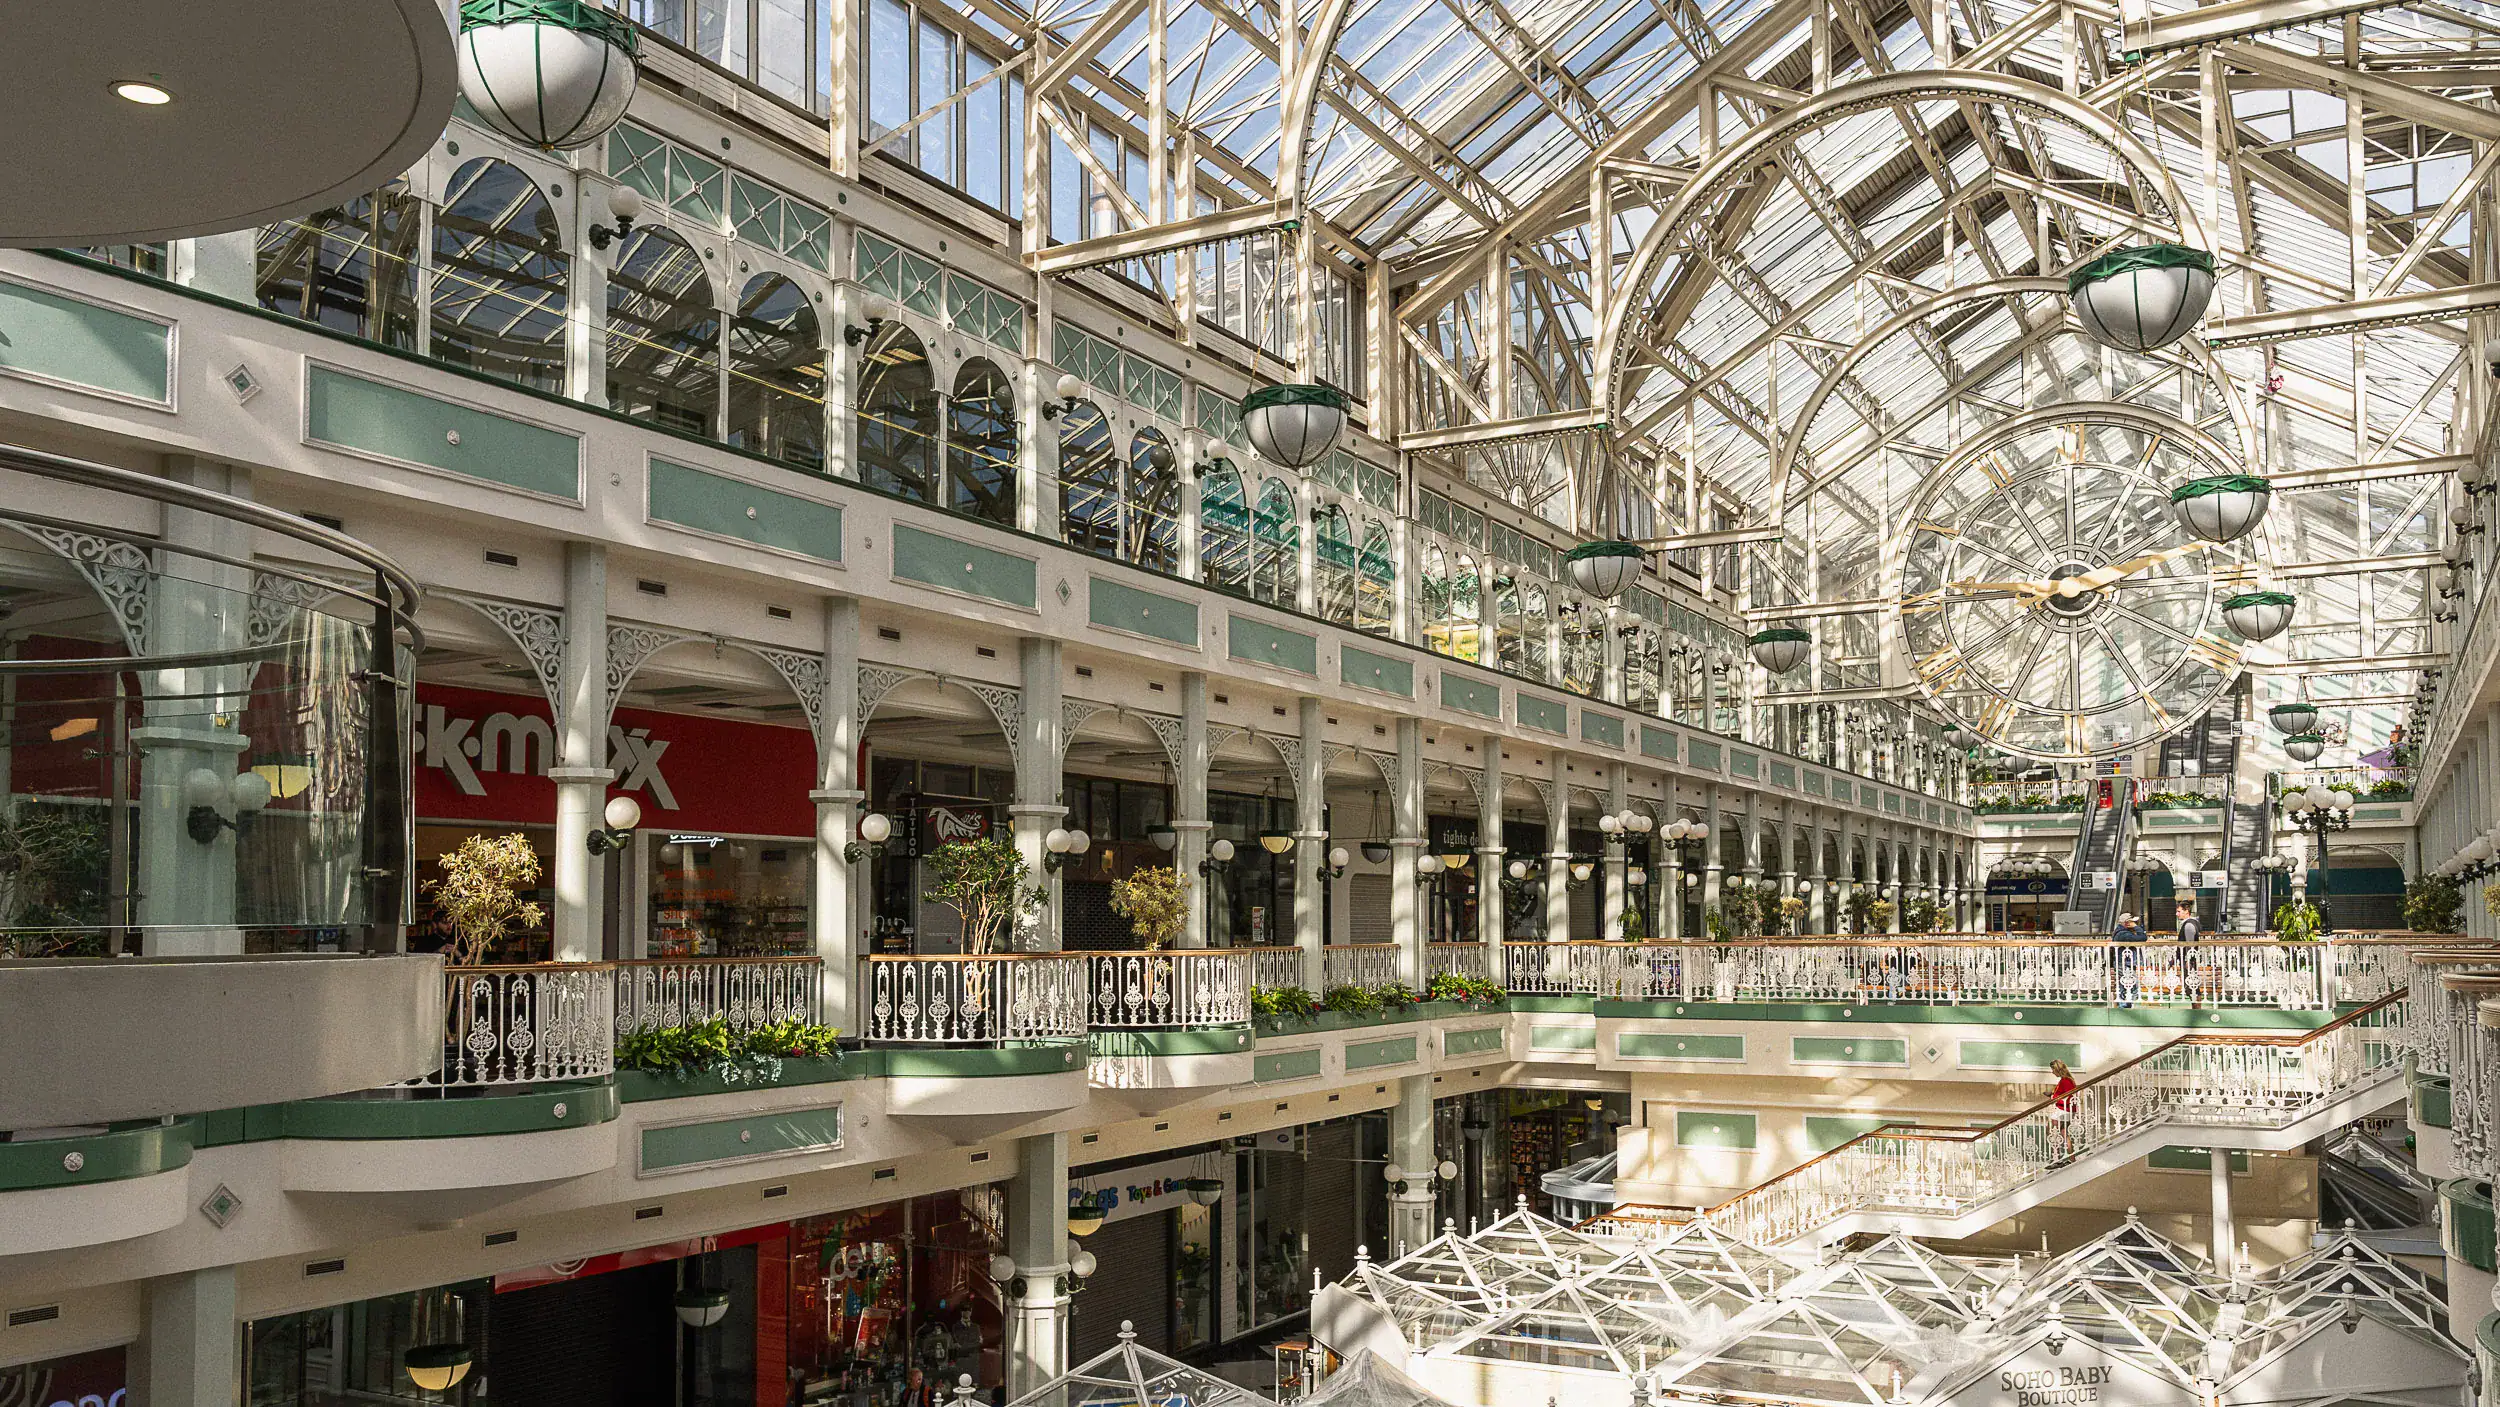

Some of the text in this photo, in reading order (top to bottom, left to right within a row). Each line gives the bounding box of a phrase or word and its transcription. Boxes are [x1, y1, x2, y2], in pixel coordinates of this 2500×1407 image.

[908, 797, 917, 857] TATTOO
[1443, 828, 1468, 848] tights
[1127, 1185, 1152, 1204] Toys
[1153, 1180, 1163, 1197] &
[2001, 1365, 2113, 1392] SOHO BABY
[2018, 1387, 2098, 1407] BOUTIQUE
